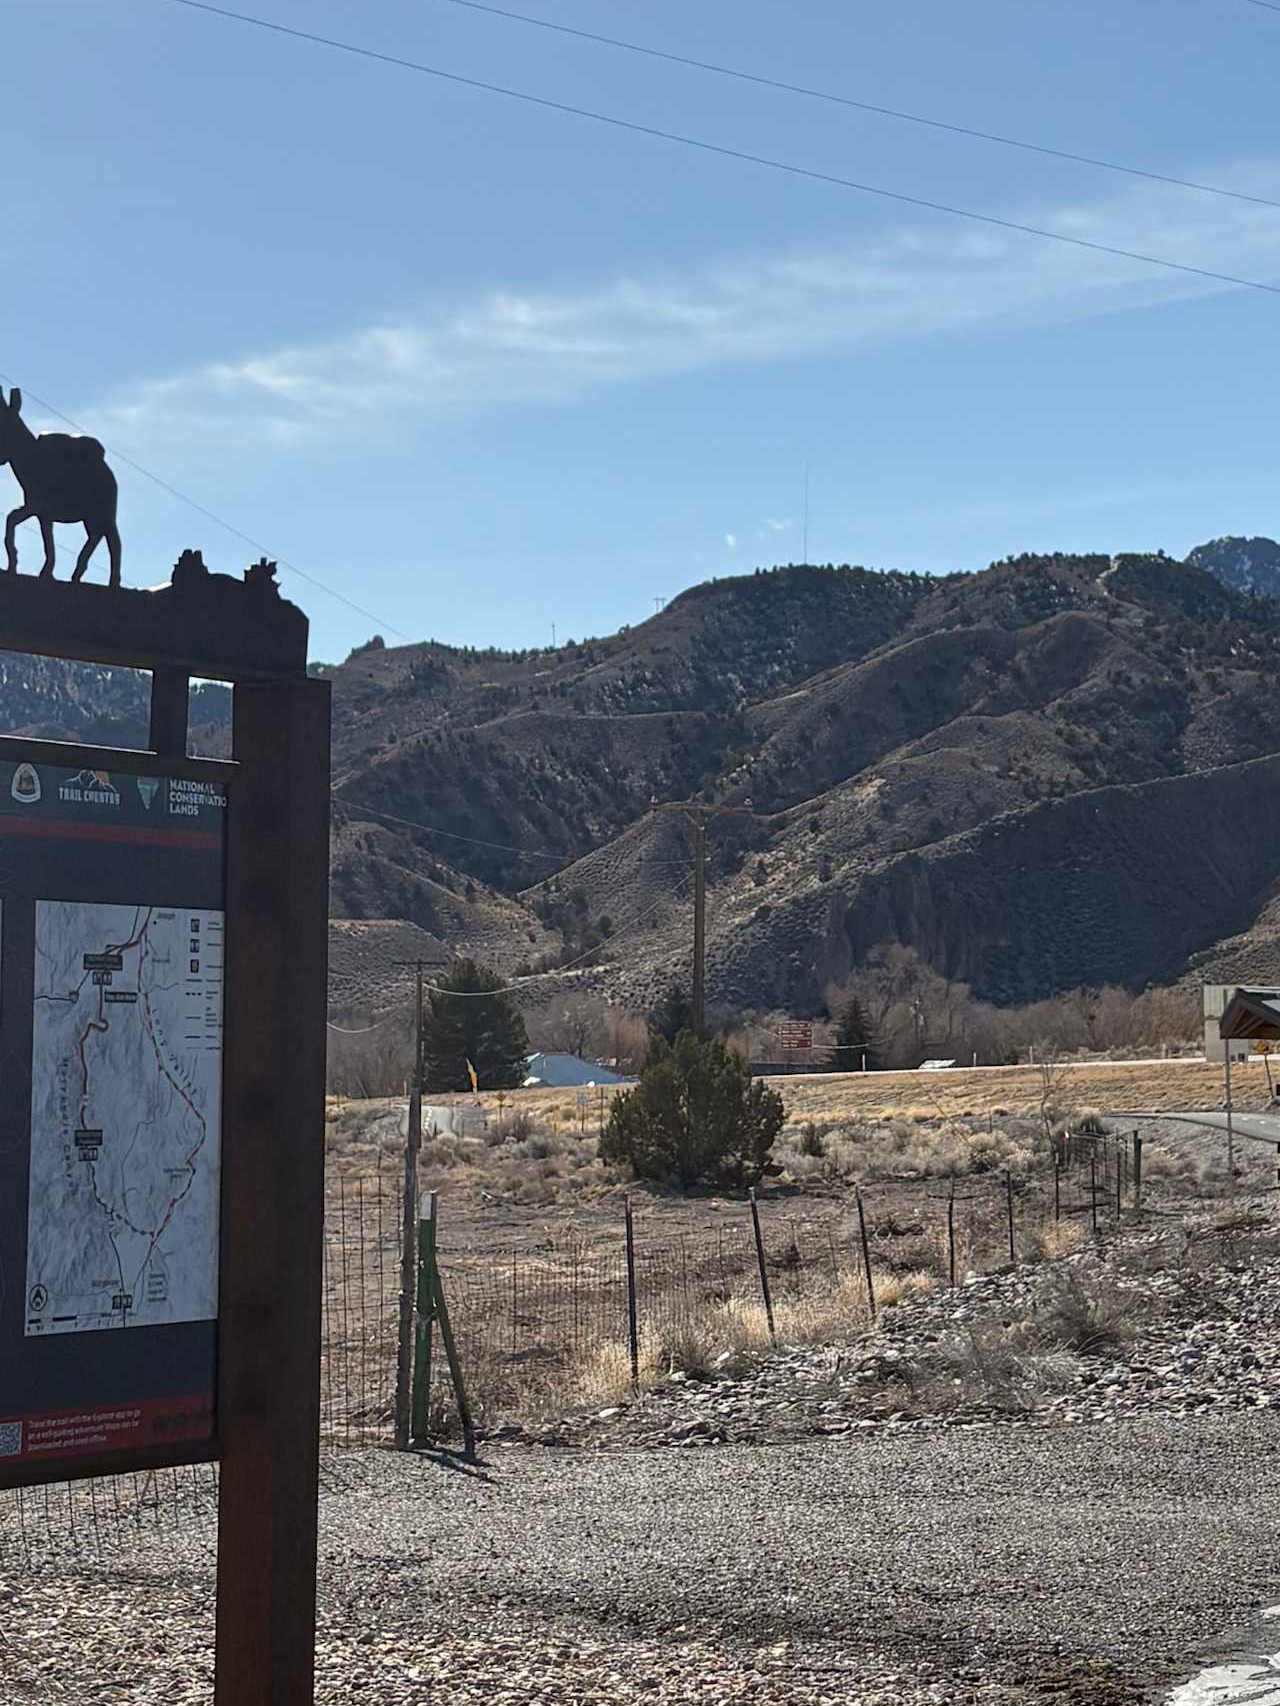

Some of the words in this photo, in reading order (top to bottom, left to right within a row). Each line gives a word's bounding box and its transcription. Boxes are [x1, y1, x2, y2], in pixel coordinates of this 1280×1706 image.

[169, 779, 216, 795] NATIONAL
[58, 787, 82, 804] TRAIL
[169, 792, 228, 807] CONSERVATIO
[169, 804, 200, 816] LANDS
